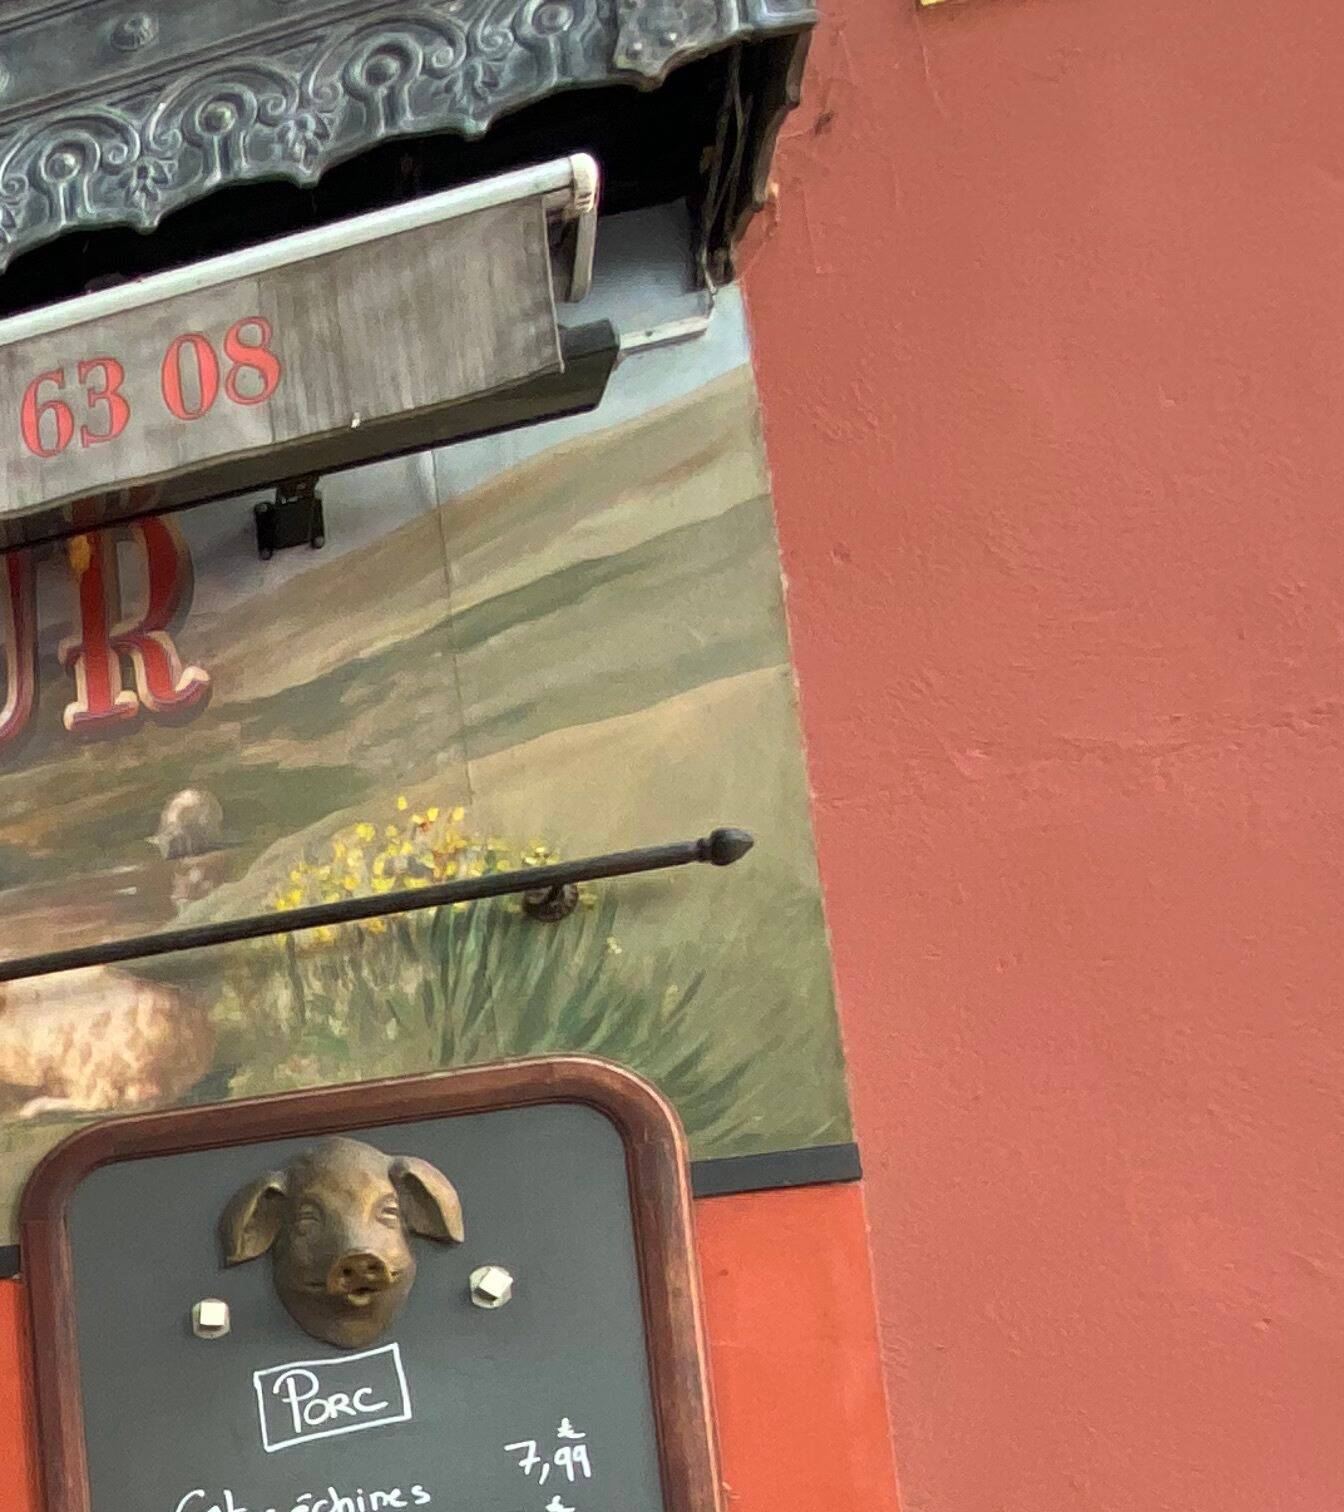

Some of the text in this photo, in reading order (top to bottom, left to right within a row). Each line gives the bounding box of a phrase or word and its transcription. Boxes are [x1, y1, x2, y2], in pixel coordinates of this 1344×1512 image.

[20, 356, 132, 458] 63
[160, 316, 283, 422] 08
[504, 1440, 592, 1485] 7,99
